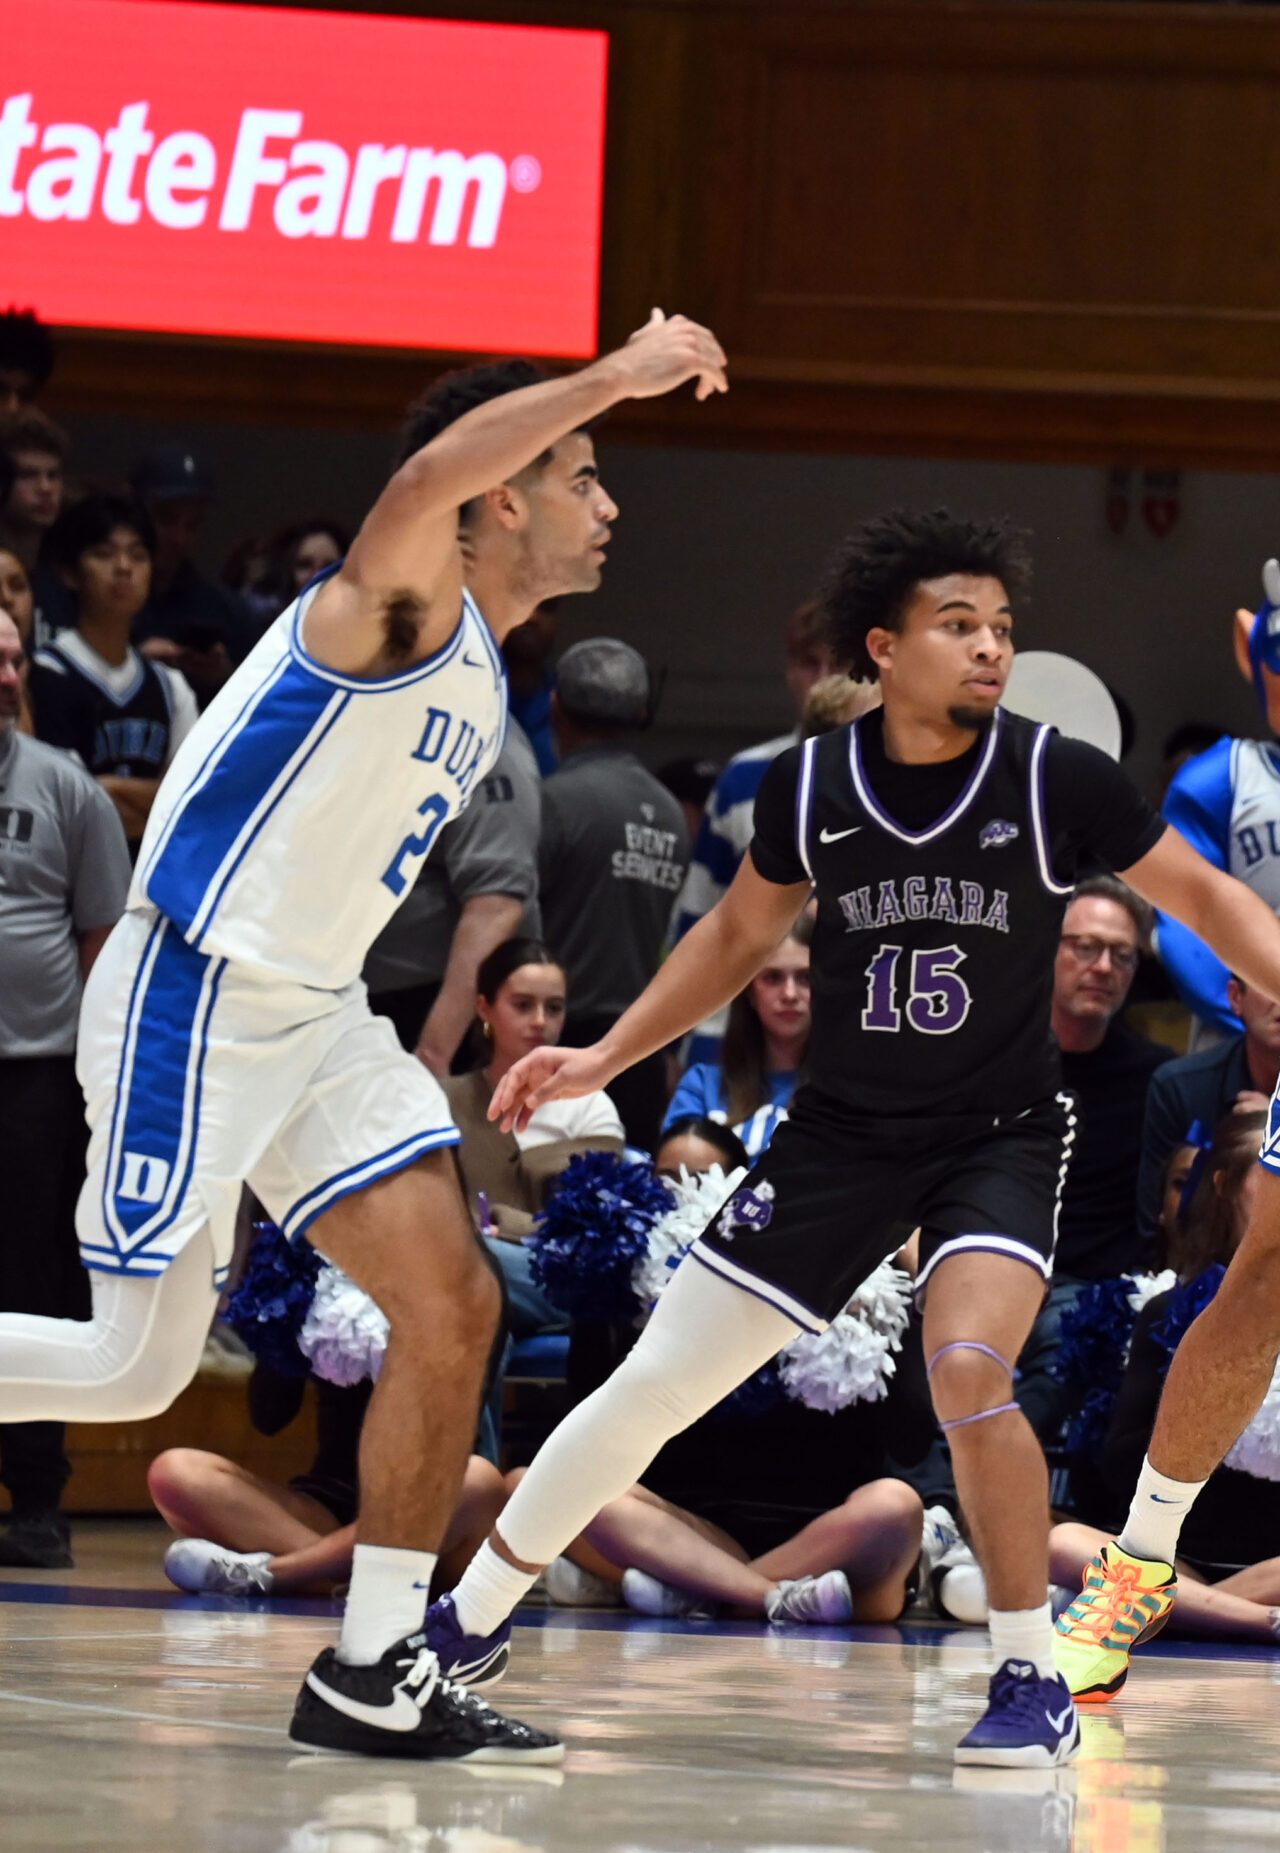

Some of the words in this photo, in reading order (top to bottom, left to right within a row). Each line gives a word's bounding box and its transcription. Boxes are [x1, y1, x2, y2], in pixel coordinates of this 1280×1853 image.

[381, 792, 450, 897] 2
[624, 821, 679, 859] EVENT
[838, 876, 1010, 933] NIAGARA
[861, 944, 974, 1035] 15
[117, 1151, 170, 1203] D
